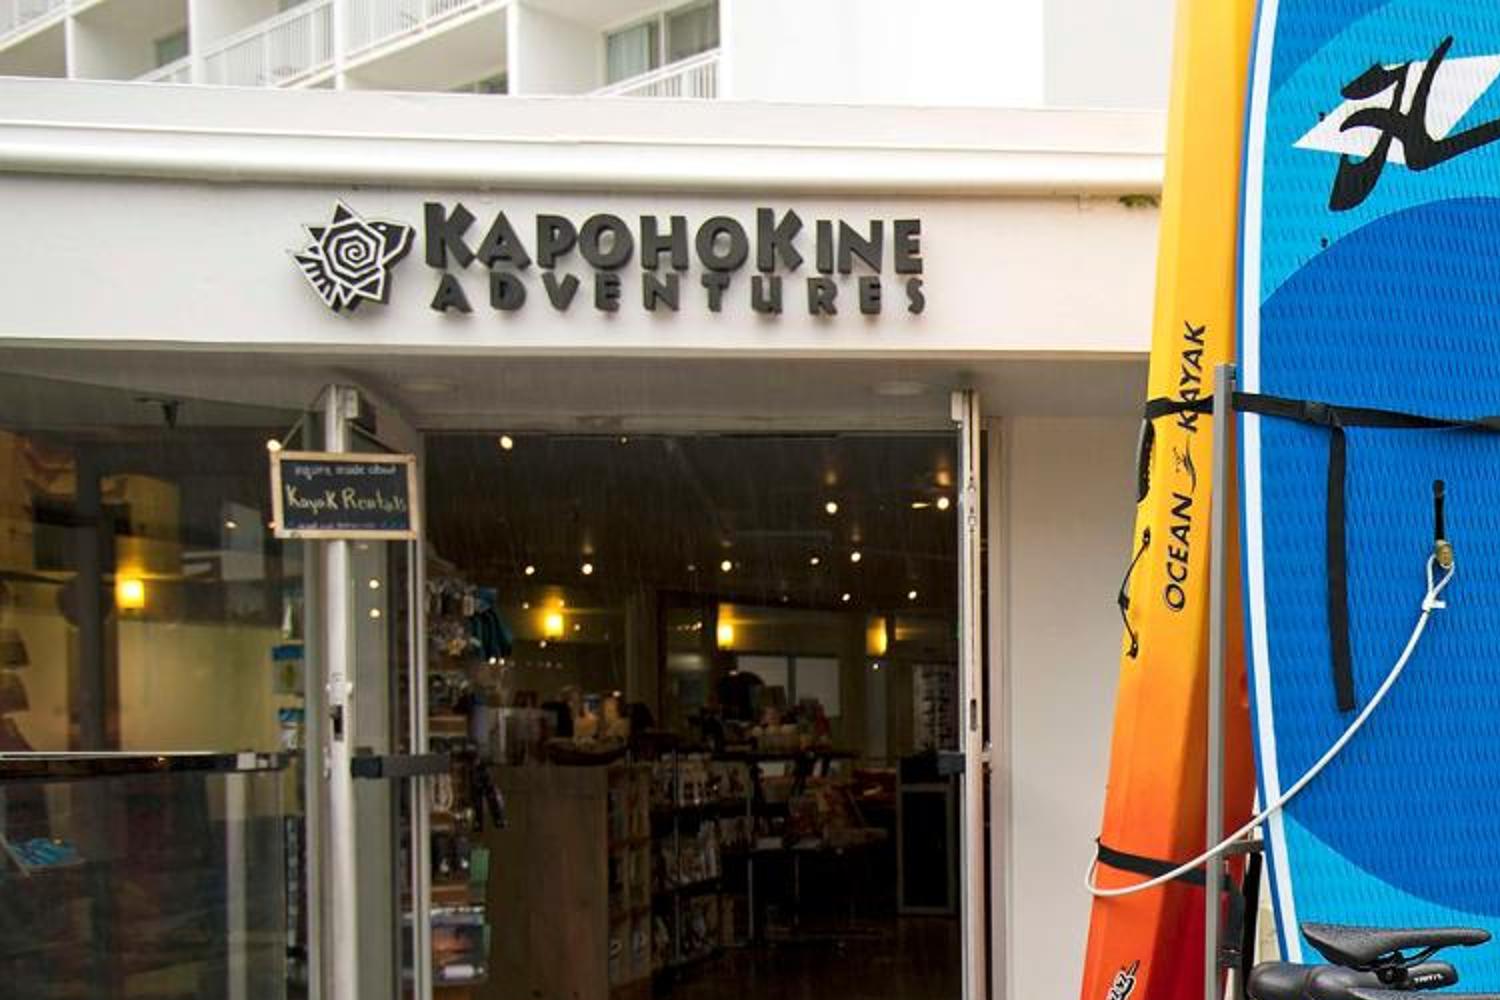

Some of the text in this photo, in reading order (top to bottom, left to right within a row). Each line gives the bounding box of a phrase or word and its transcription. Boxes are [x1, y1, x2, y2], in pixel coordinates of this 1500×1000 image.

[424, 202, 924, 275] KAPOHOKINE
[430, 272, 926, 315] ADVENTURES
[1164, 320, 1206, 612] OCEAN KAYAK
